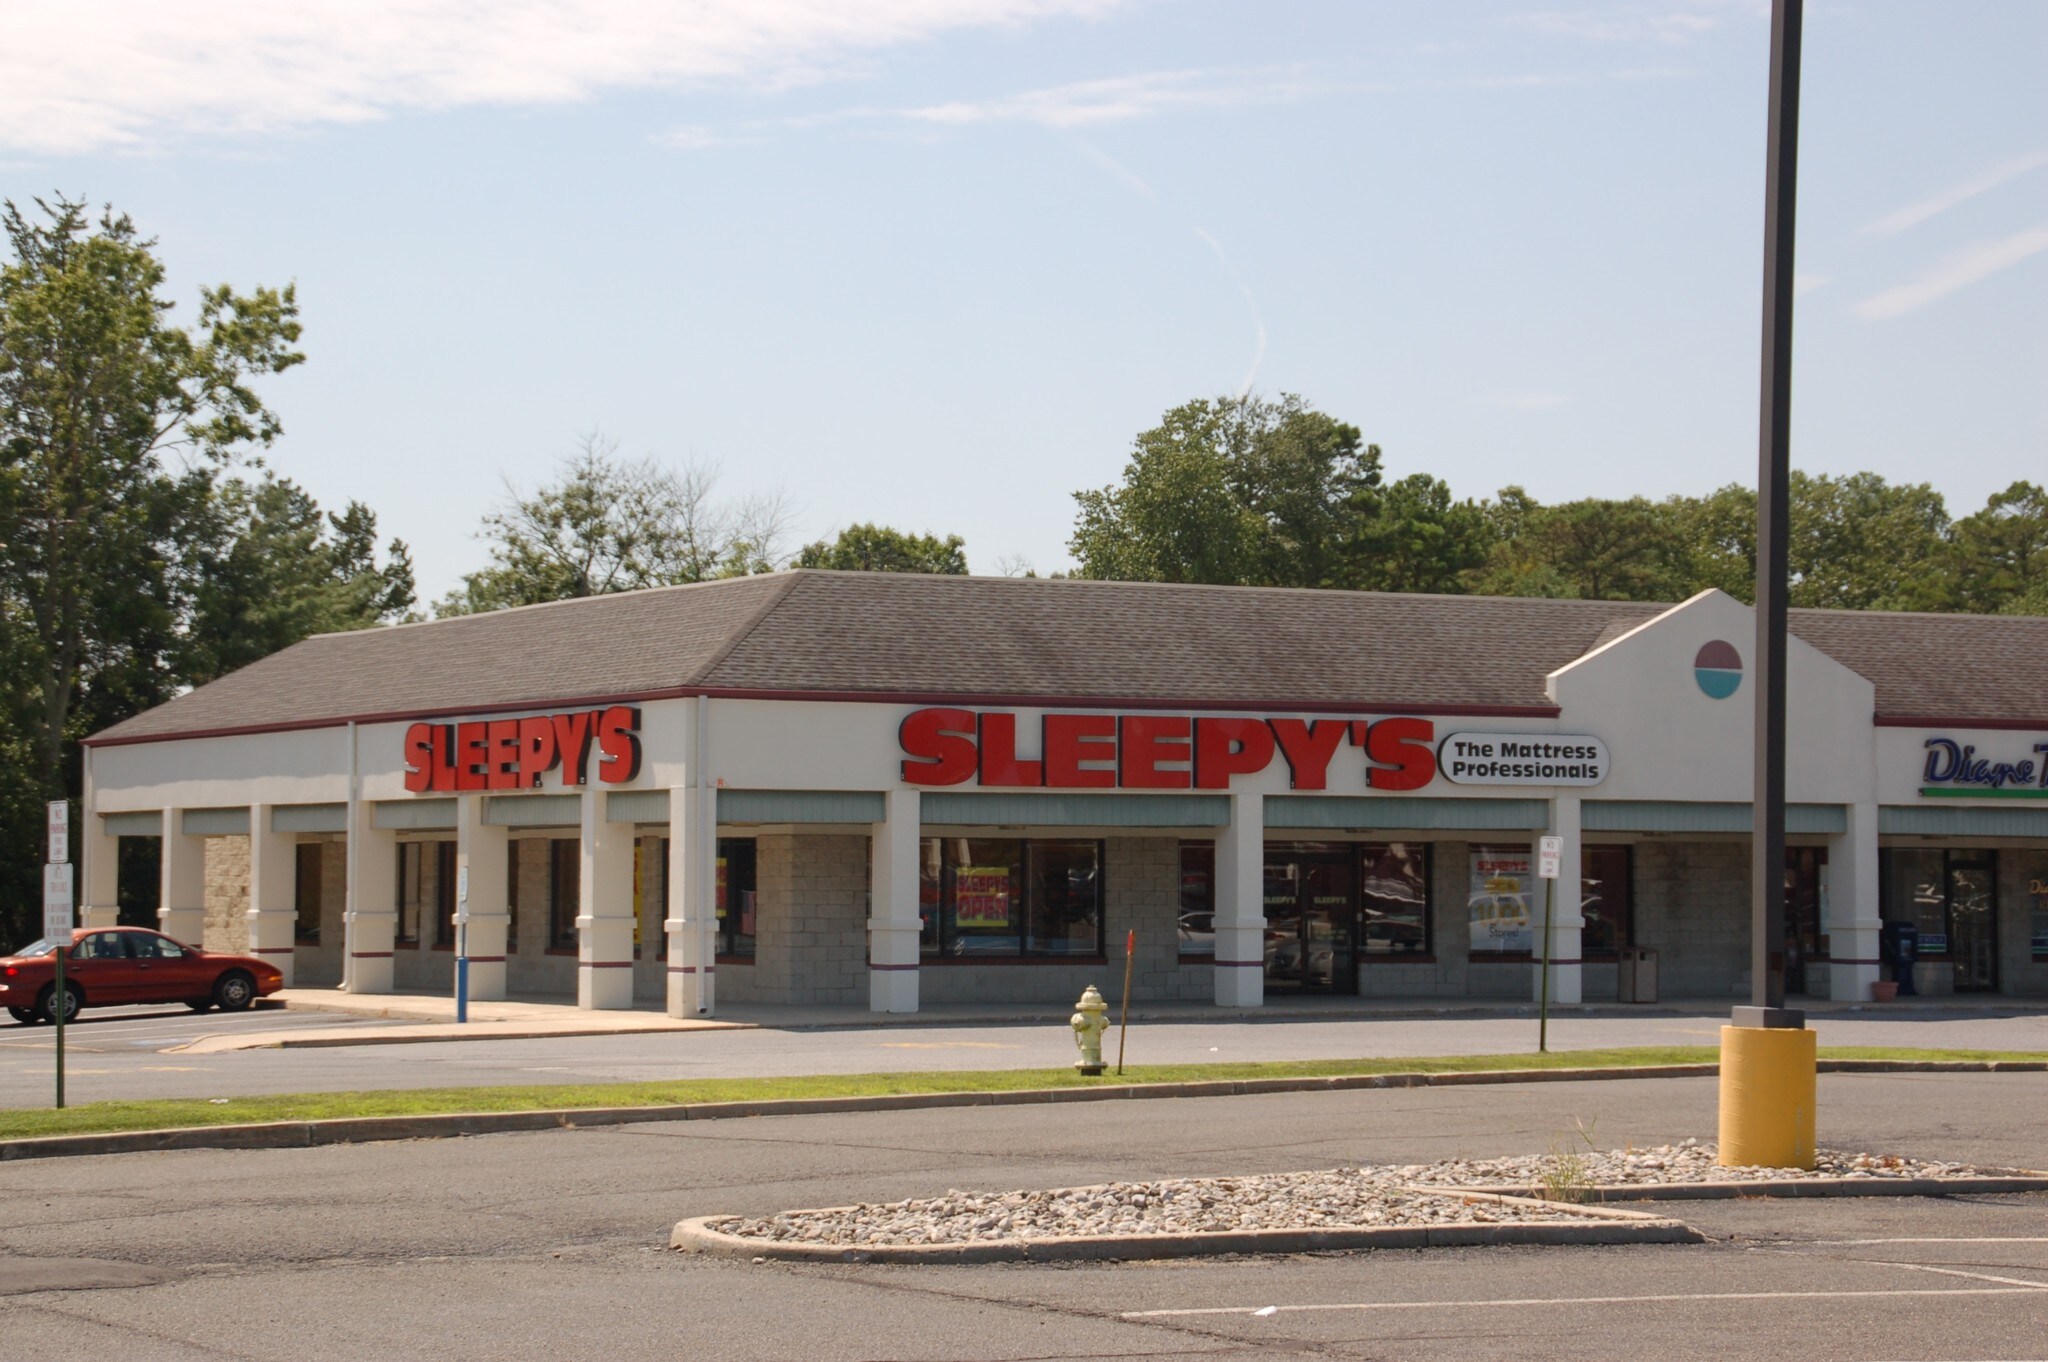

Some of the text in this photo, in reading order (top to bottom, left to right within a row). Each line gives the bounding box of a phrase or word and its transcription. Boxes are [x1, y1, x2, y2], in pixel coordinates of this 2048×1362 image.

[404, 705, 642, 792] SLEEPY'S
[899, 707, 1436, 790] SLEEPY'S
[1453, 761, 1599, 779] Professionals
[1454, 742, 1597, 759] The Mattress
[1922, 738, 2035, 788] Diane
